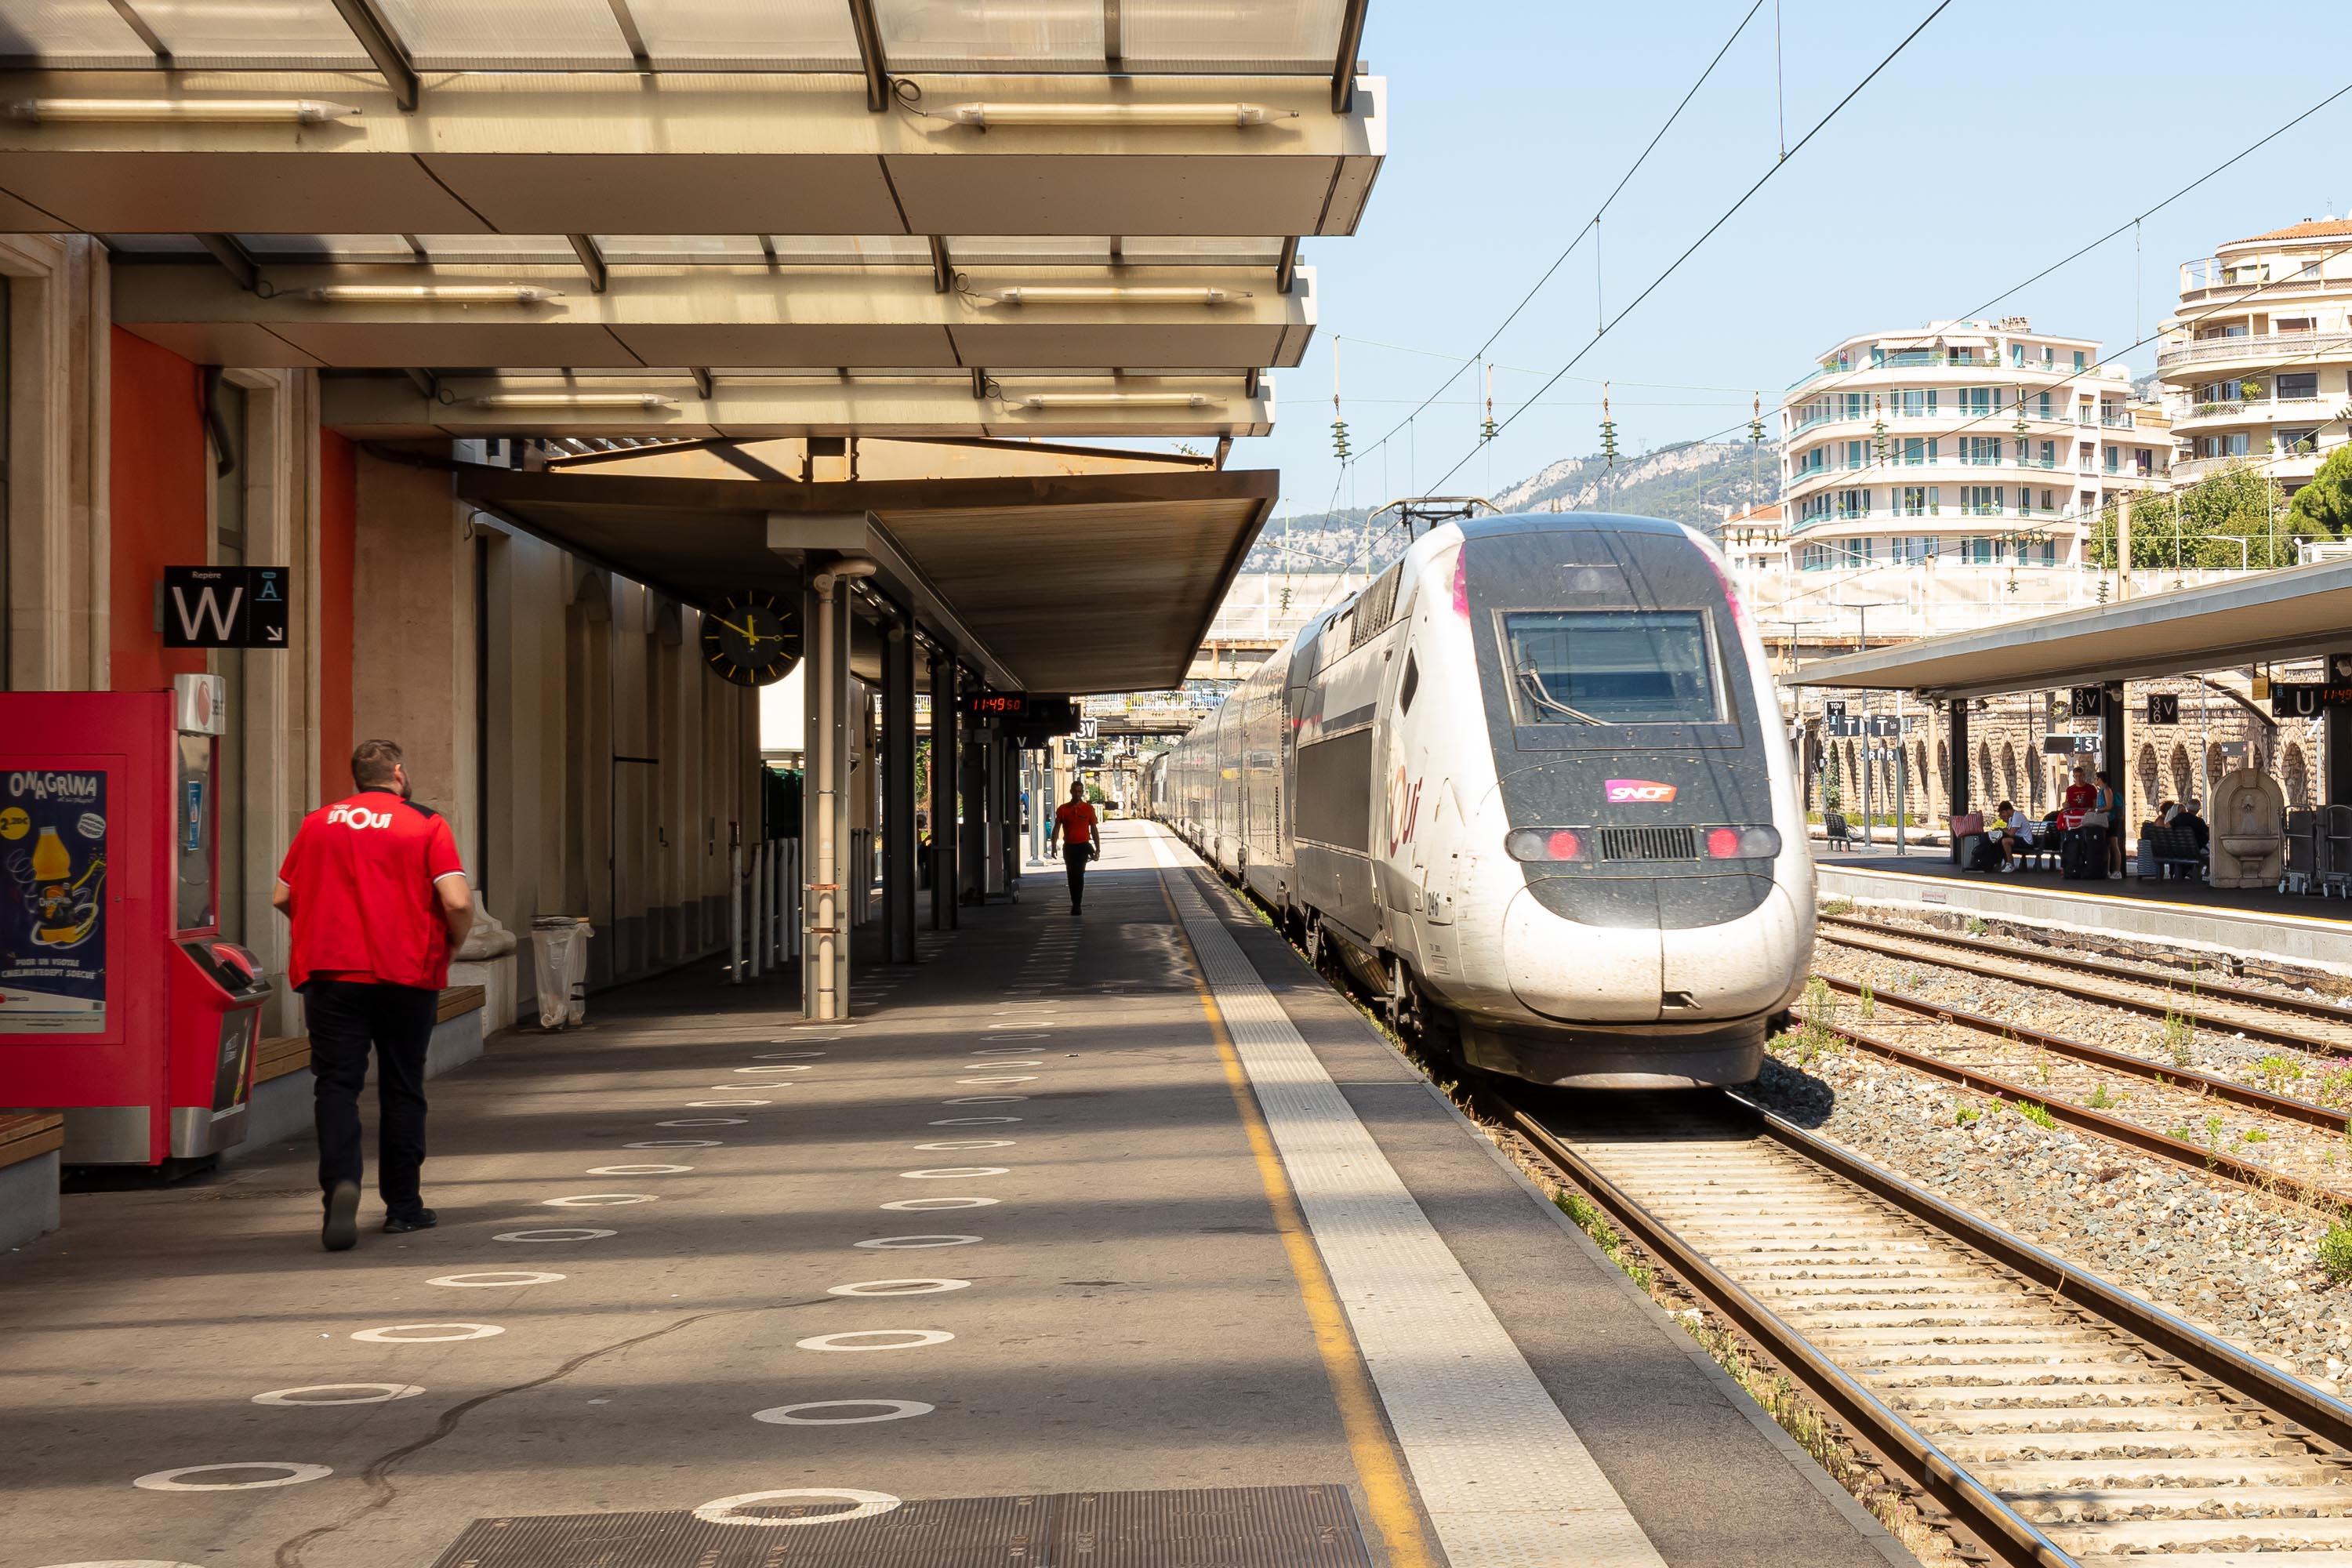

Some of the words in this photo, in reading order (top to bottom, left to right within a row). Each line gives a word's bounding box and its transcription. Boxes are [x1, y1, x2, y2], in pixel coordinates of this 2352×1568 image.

[261, 581, 277, 598] A
[172, 586, 243, 641] W
[2076, 689, 2083, 702] 3
[2086, 695, 2096, 708] V
[974, 698, 1005, 710] 11:49
[2076, 702, 2084, 715] 6
[2153, 696, 2161, 710] 3
[2164, 702, 2173, 715] V
[2296, 691, 2314, 715] U
[2153, 710, 2161, 723] 6
[1844, 720, 1856, 735] T
[1876, 720, 1888, 735] T
[1017, 736, 1027, 747] V
[1066, 742, 1073, 754] T
[2085, 739, 2093, 752] S
[1080, 750, 1087, 760] S
[1868, 751, 1875, 760] R
[1886, 751, 1893, 760] R
[9, 771, 98, 800] ONAGRINA
[1610, 787, 1671, 800] SNCF
